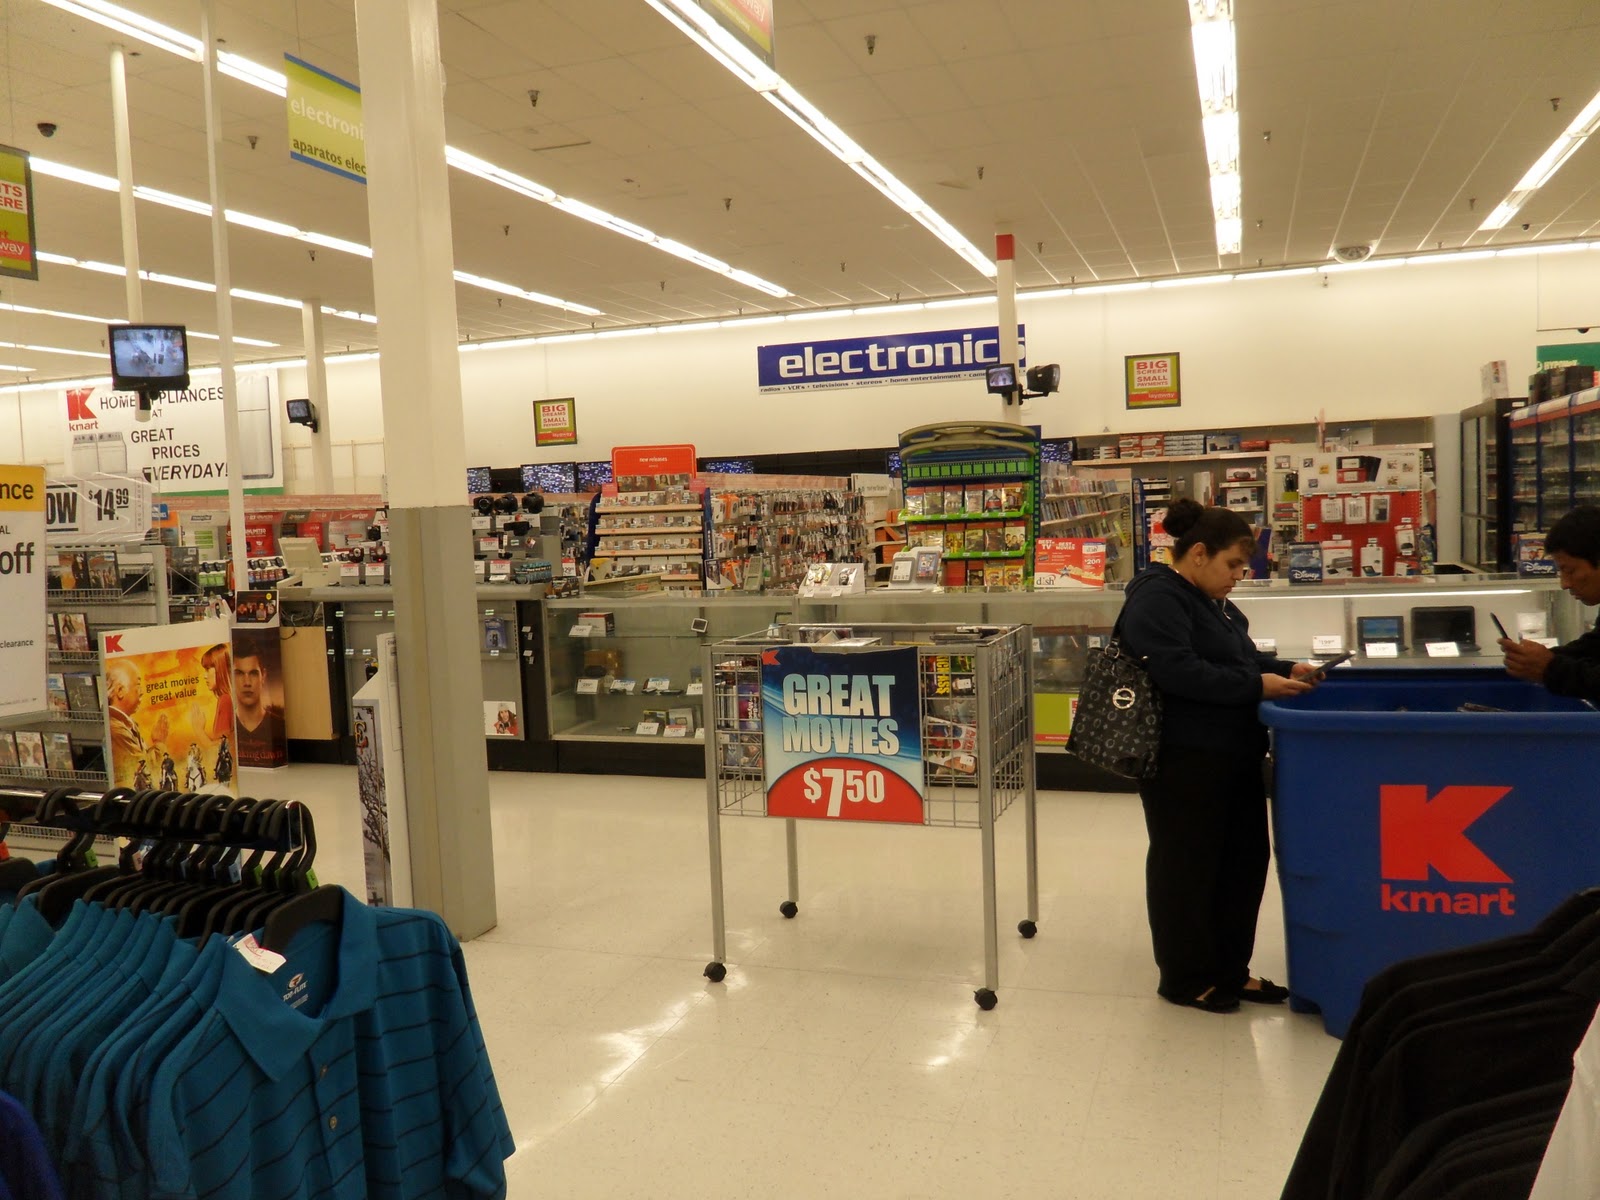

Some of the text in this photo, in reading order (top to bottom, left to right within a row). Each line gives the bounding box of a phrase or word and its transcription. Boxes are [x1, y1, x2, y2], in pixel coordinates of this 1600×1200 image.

[293, 139, 342, 165] aparatos
[0, 183, 22, 198] TS
[1136, 360, 1168, 370] BIG
[812, 381, 849, 389] televisions
[910, 373, 961, 382] entertainment
[1136, 375, 1168, 383] SMALL
[100, 387, 224, 410] HOME PLIANCES
[152, 408, 163, 418] AT
[541, 404, 567, 413] BIG
[69, 421, 99, 432] kmart
[131, 427, 175, 444] GREAT
[152, 444, 201, 460] PRICES
[0, 541, 35, 575] off
[1291, 569, 1320, 580] Disney
[0, 639, 34, 649] clearance
[145, 675, 200, 694] great movies
[150, 687, 197, 706] great value
[782, 673, 896, 717] GREAT
[782, 716, 900, 756] MOVIES
[1380, 883, 1516, 916] kmart
